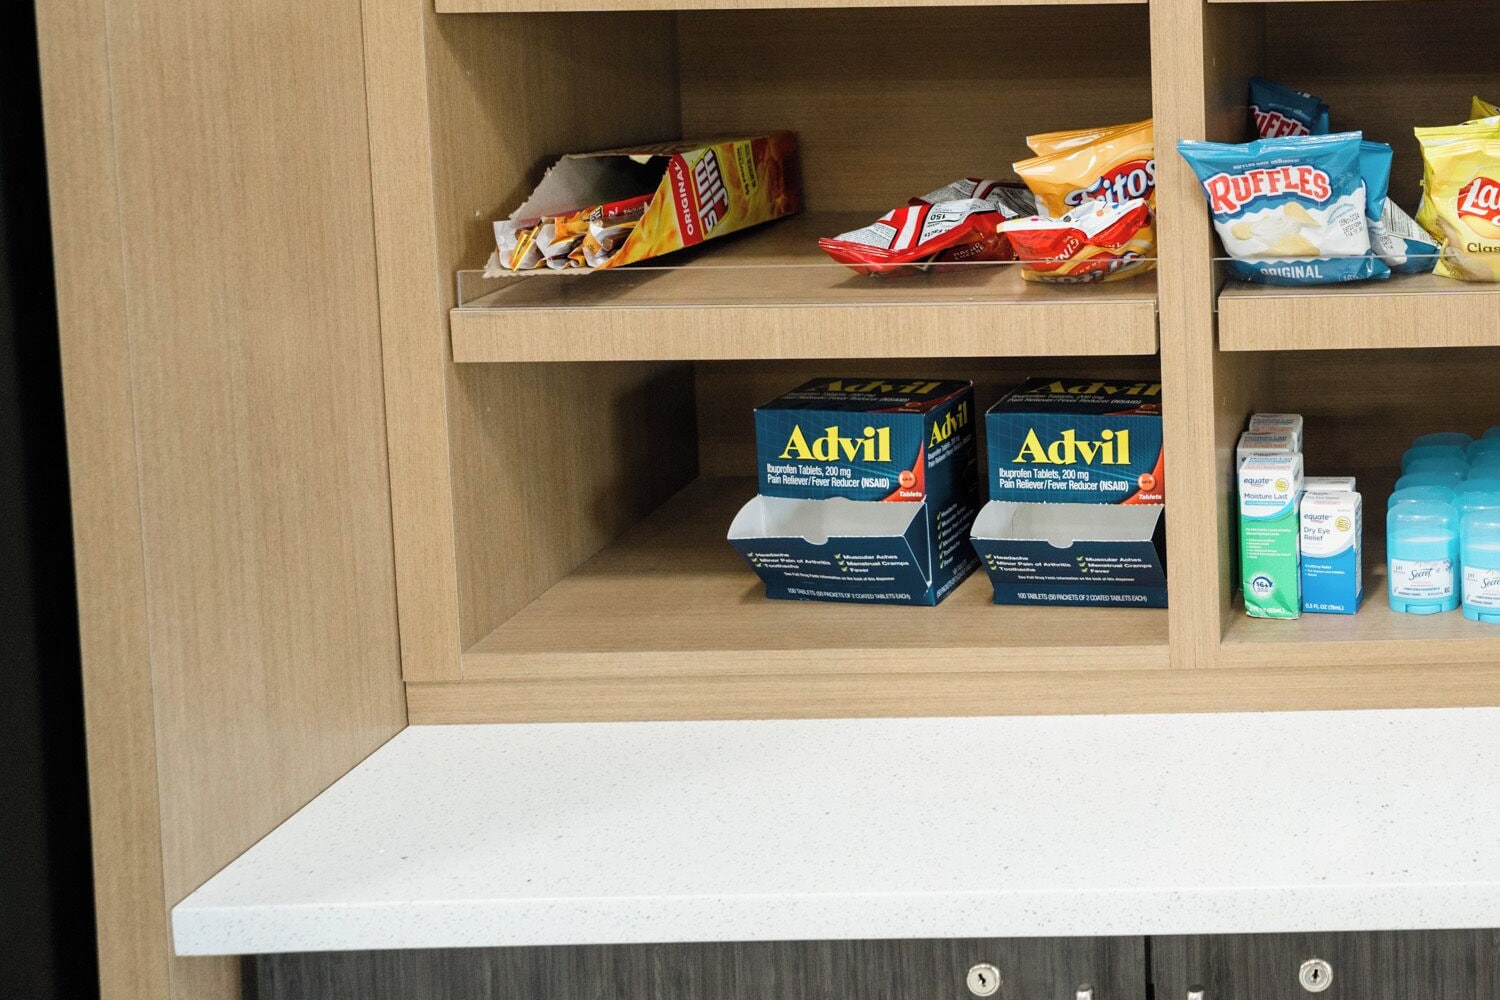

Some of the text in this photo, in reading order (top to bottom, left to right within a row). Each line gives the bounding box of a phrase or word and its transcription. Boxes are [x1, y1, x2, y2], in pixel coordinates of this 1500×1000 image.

[1206, 167, 1331, 213] RUFFLES
[673, 161, 694, 236] ORIGINAL
[953, 242, 981, 258] NACHO
[1260, 264, 1324, 280] ORIGINAL
[812, 380, 943, 395] Advil
[1028, 380, 1162, 396] Advil
[928, 401, 968, 449] Advil
[778, 424, 892, 462] Advil
[1012, 427, 1132, 466] Advil
[767, 463, 852, 479] Ibuprofen Tablets, 200 mg
[999, 467, 1090, 482] Ibuprofen Tablets, 200 mg
[768, 474, 782, 485] Pain
[831, 477, 860, 488] Reducer
[861, 478, 890, 490] (NSAID)
[1000, 478, 1015, 489] Pain
[1068, 480, 1098, 491] Reducer
[1099, 481, 1129, 492] (NSAID)
[1244, 477, 1270, 486] equate
[1244, 492, 1288, 500] Moisture Last
[1303, 513, 1330, 521] equate
[1304, 526, 1331, 535] Dry Eye
[1409, 567, 1433, 581] Secret
